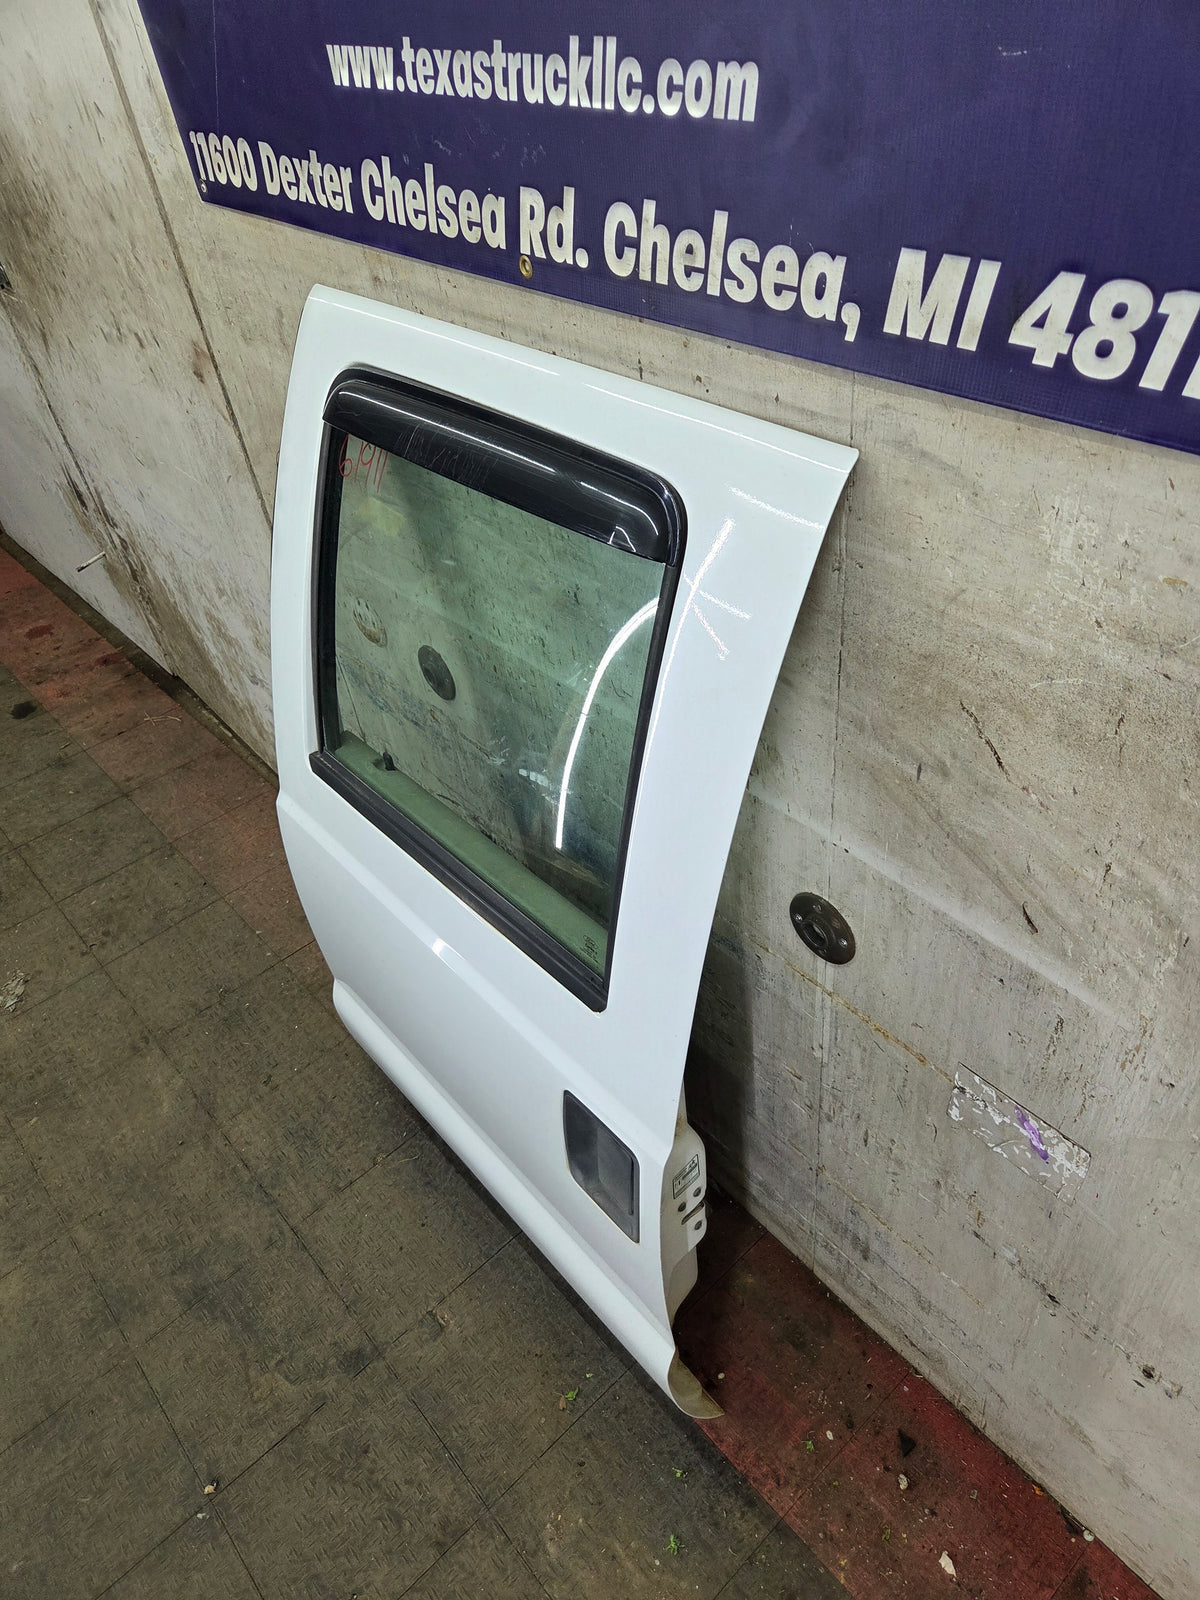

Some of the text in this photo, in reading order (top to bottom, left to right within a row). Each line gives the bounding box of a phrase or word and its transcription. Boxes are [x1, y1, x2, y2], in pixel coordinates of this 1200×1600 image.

[326, 35, 760, 121] www.texastruckllc.com
[189, 131, 1200, 400] 11600 Dexter Chelsea Rd. Chelsea, MI 481
